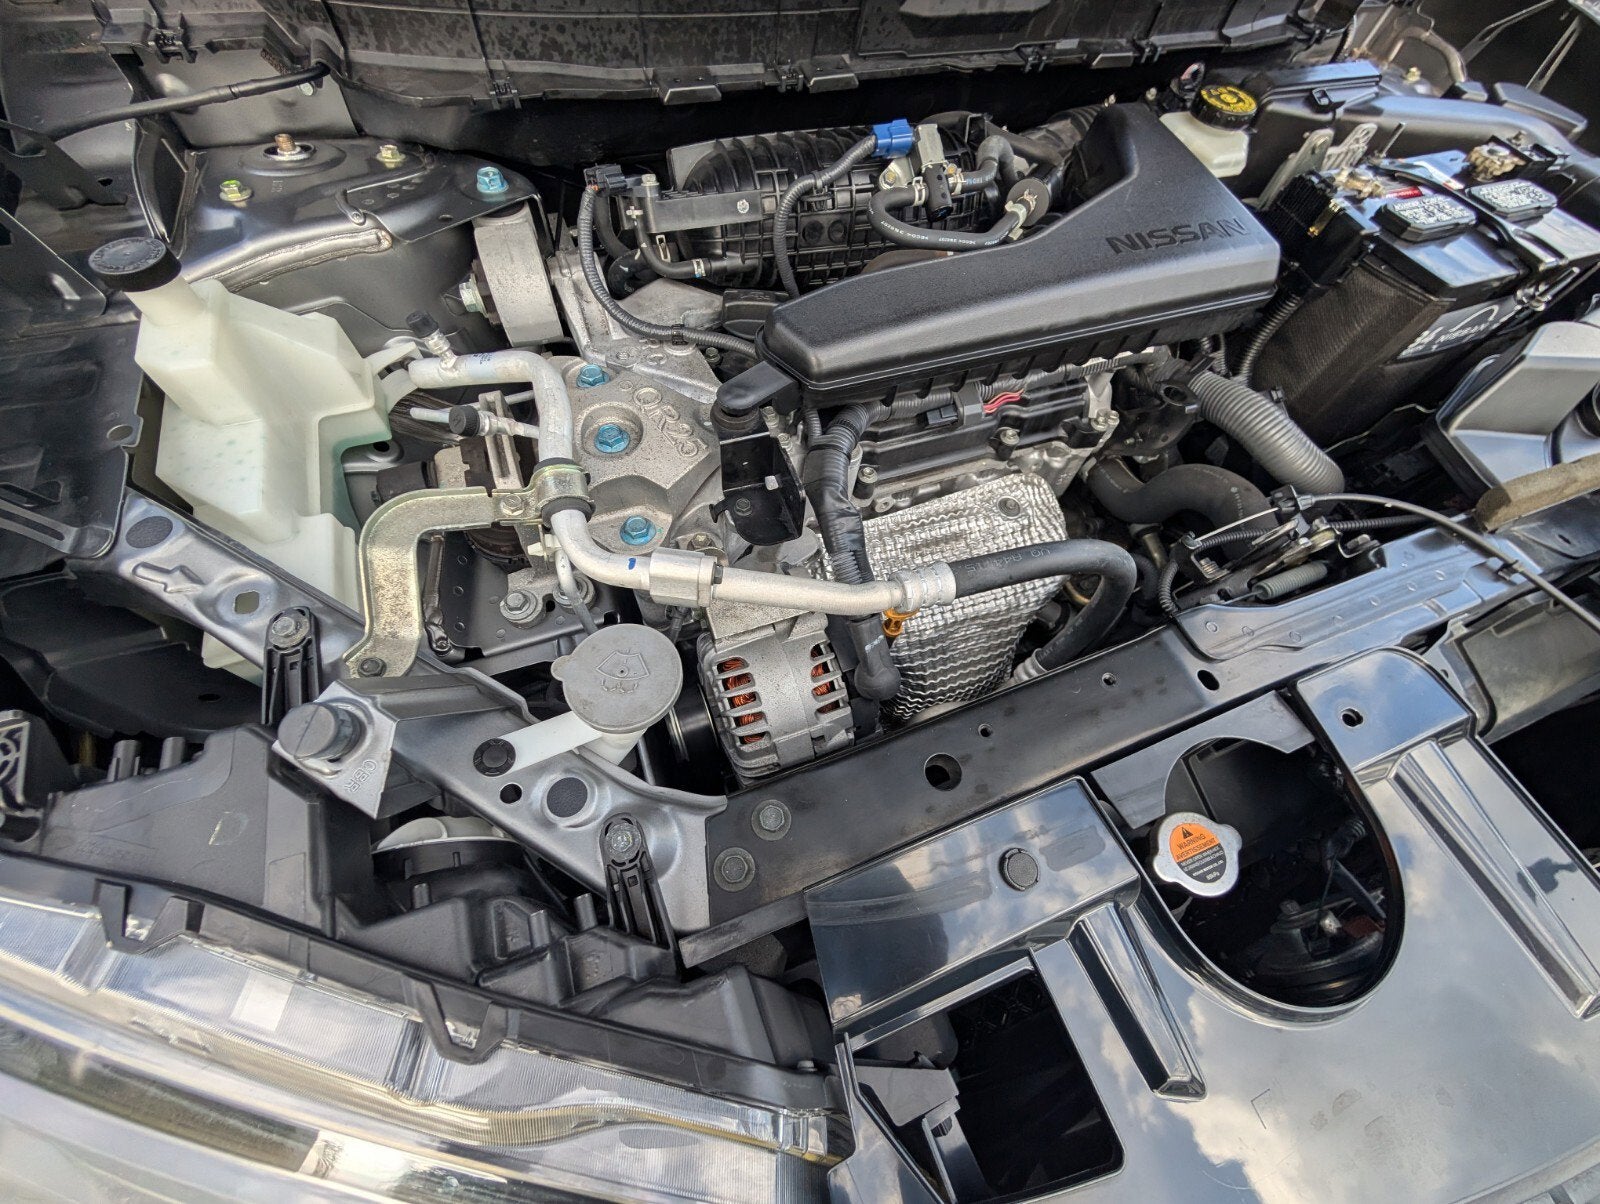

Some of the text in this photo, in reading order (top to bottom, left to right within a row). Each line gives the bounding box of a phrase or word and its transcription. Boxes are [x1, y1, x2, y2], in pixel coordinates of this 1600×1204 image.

[1105, 218, 1248, 254] NISSAN
[634, 387, 709, 457] QR25
[1175, 837, 1216, 860] AVERTISSEMENT
[1177, 833, 1206, 850] WARNING
